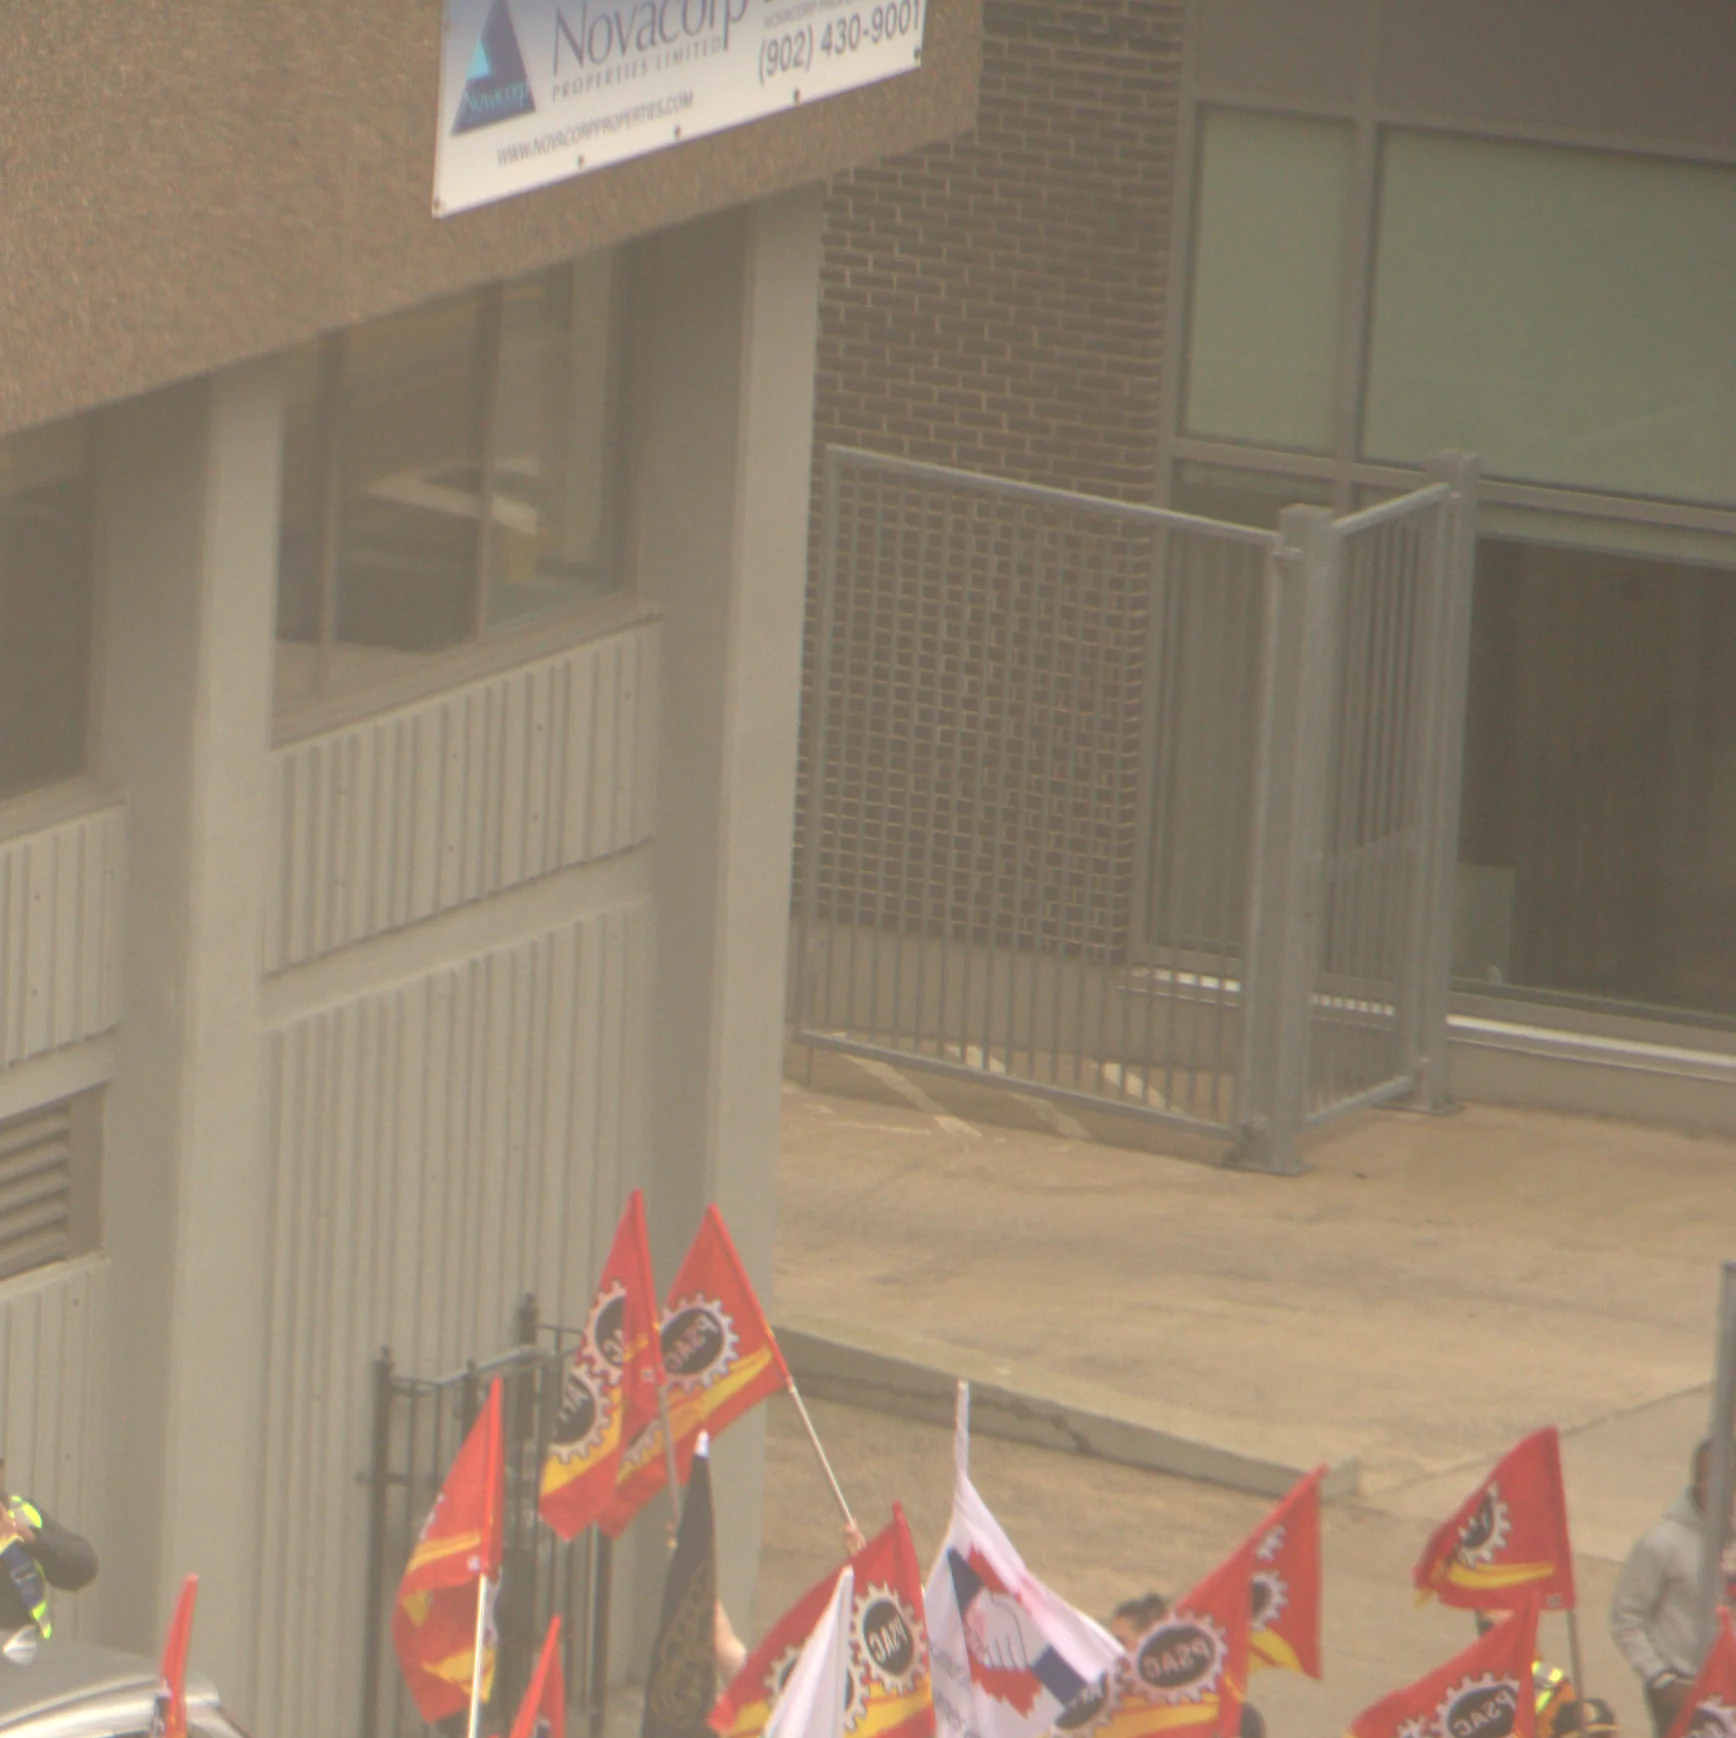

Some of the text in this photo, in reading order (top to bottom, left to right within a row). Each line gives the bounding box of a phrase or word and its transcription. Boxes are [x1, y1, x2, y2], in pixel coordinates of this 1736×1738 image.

[552, 0, 747, 76] Novacorp
[552, 35, 723, 103] PROPERTIES LIMITED
[758, 0, 920, 88] (902) 430-9001
[464, 80, 527, 113] Novacorp
